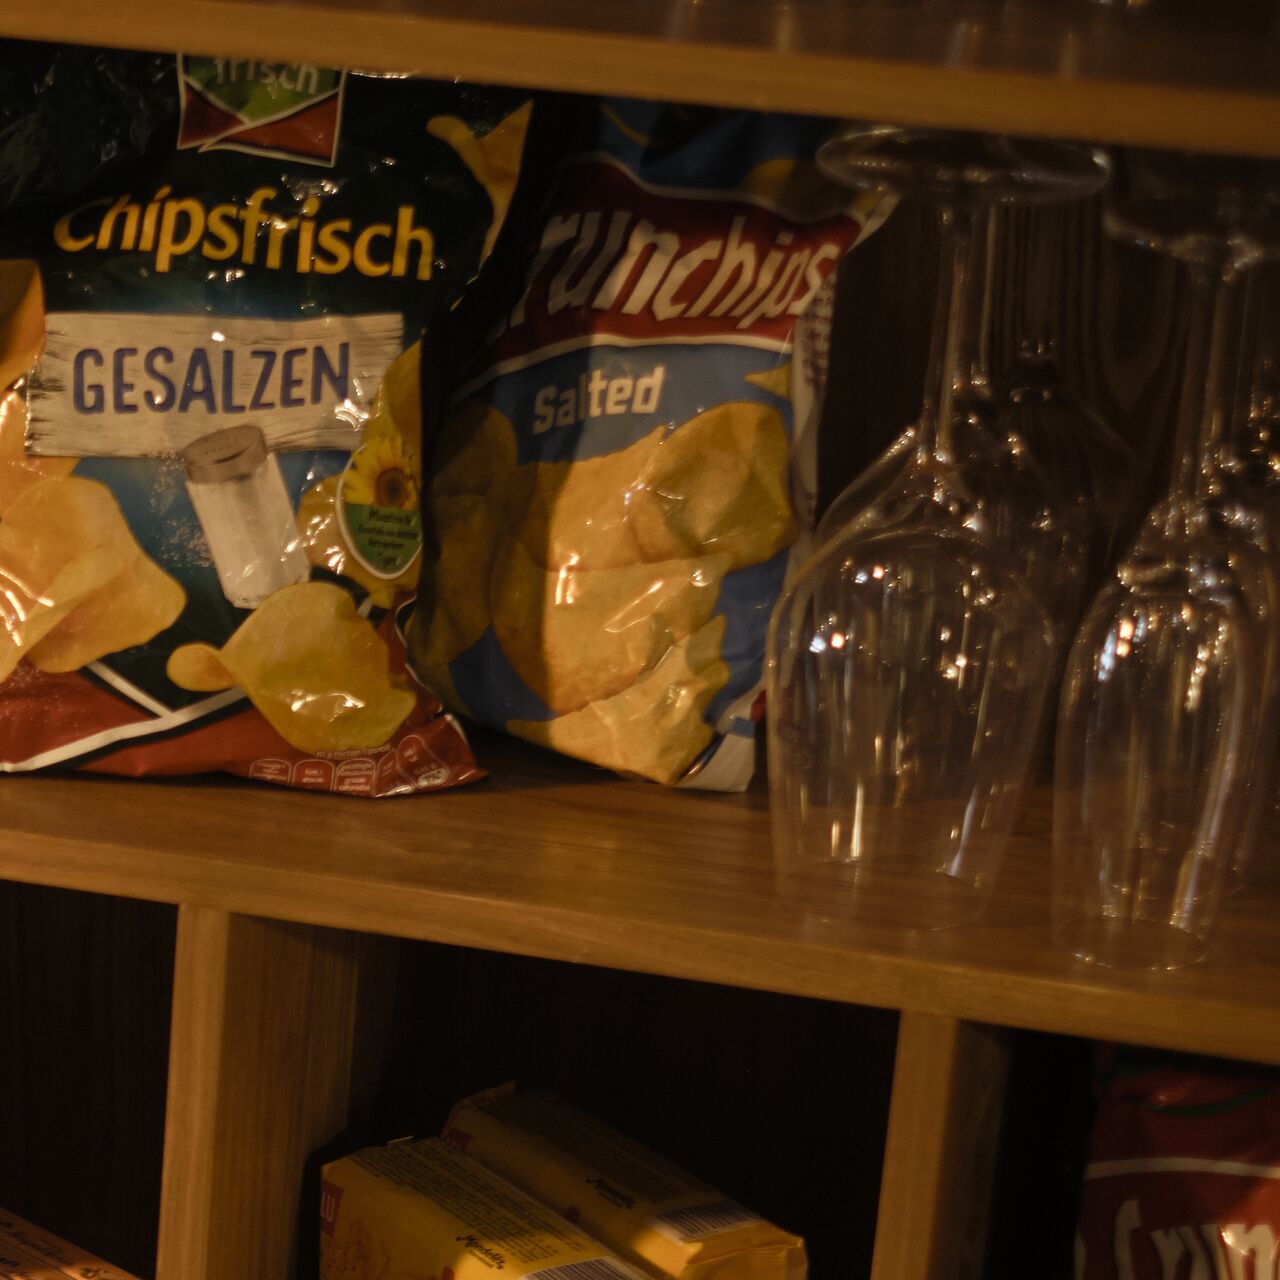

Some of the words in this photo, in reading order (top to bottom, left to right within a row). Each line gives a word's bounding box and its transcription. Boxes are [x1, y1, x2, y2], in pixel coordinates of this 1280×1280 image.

[53, 185, 435, 281] Chipsfrisch
[487, 211, 840, 346] runchips
[73, 343, 349, 414] GESALZEN
[532, 366, 666, 434] Salted
